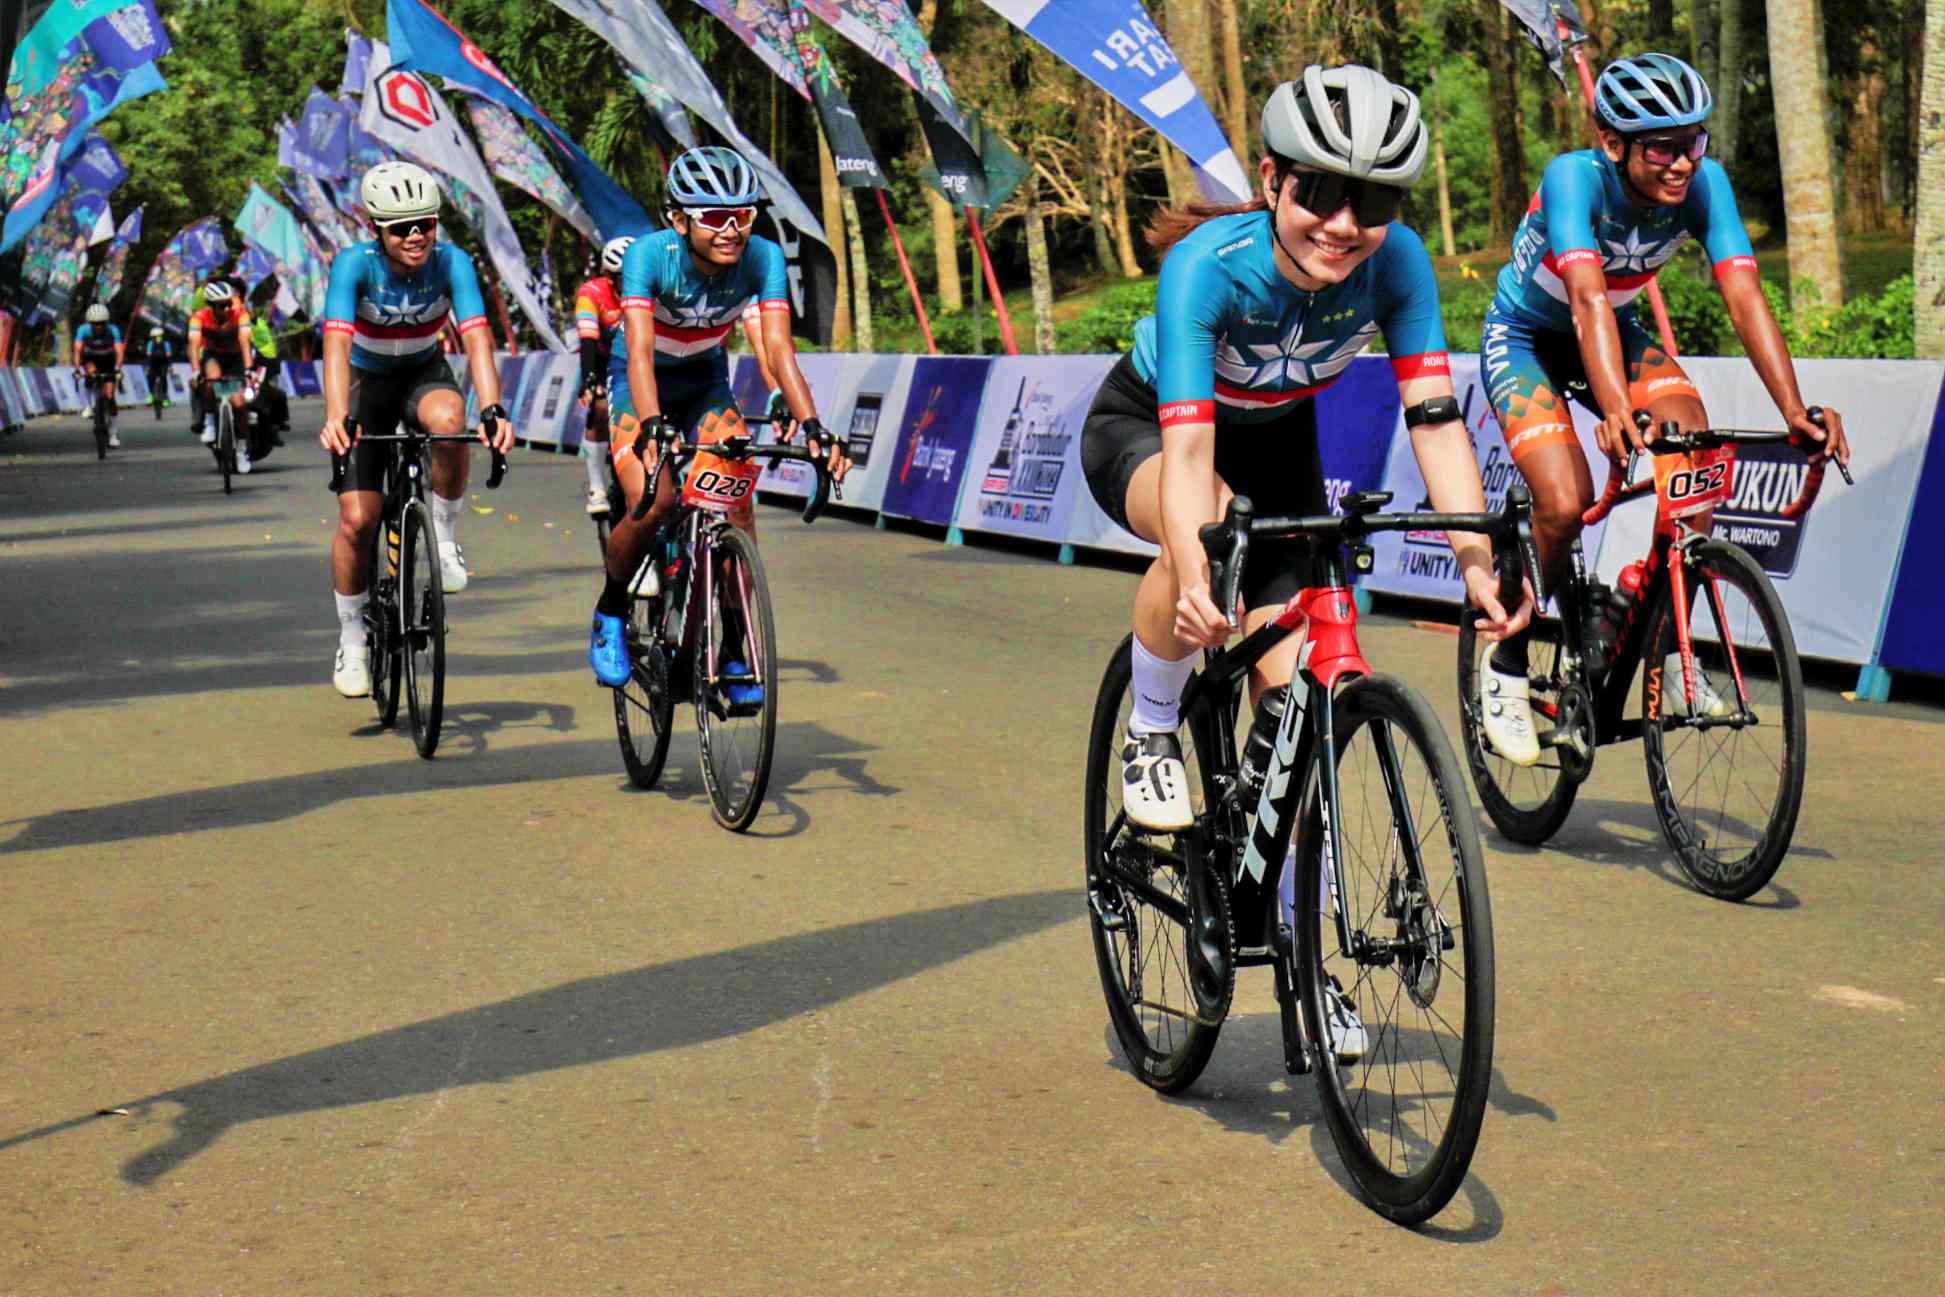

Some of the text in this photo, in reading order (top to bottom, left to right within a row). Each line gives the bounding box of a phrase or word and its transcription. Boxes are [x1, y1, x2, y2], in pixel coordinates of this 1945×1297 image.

[694, 471, 751, 497] 028
[1668, 463, 1727, 501] 052
[1726, 460, 1809, 513] UKUN
[1730, 525, 1780, 547] WARTONO
[1409, 551, 1450, 579] UNITY
